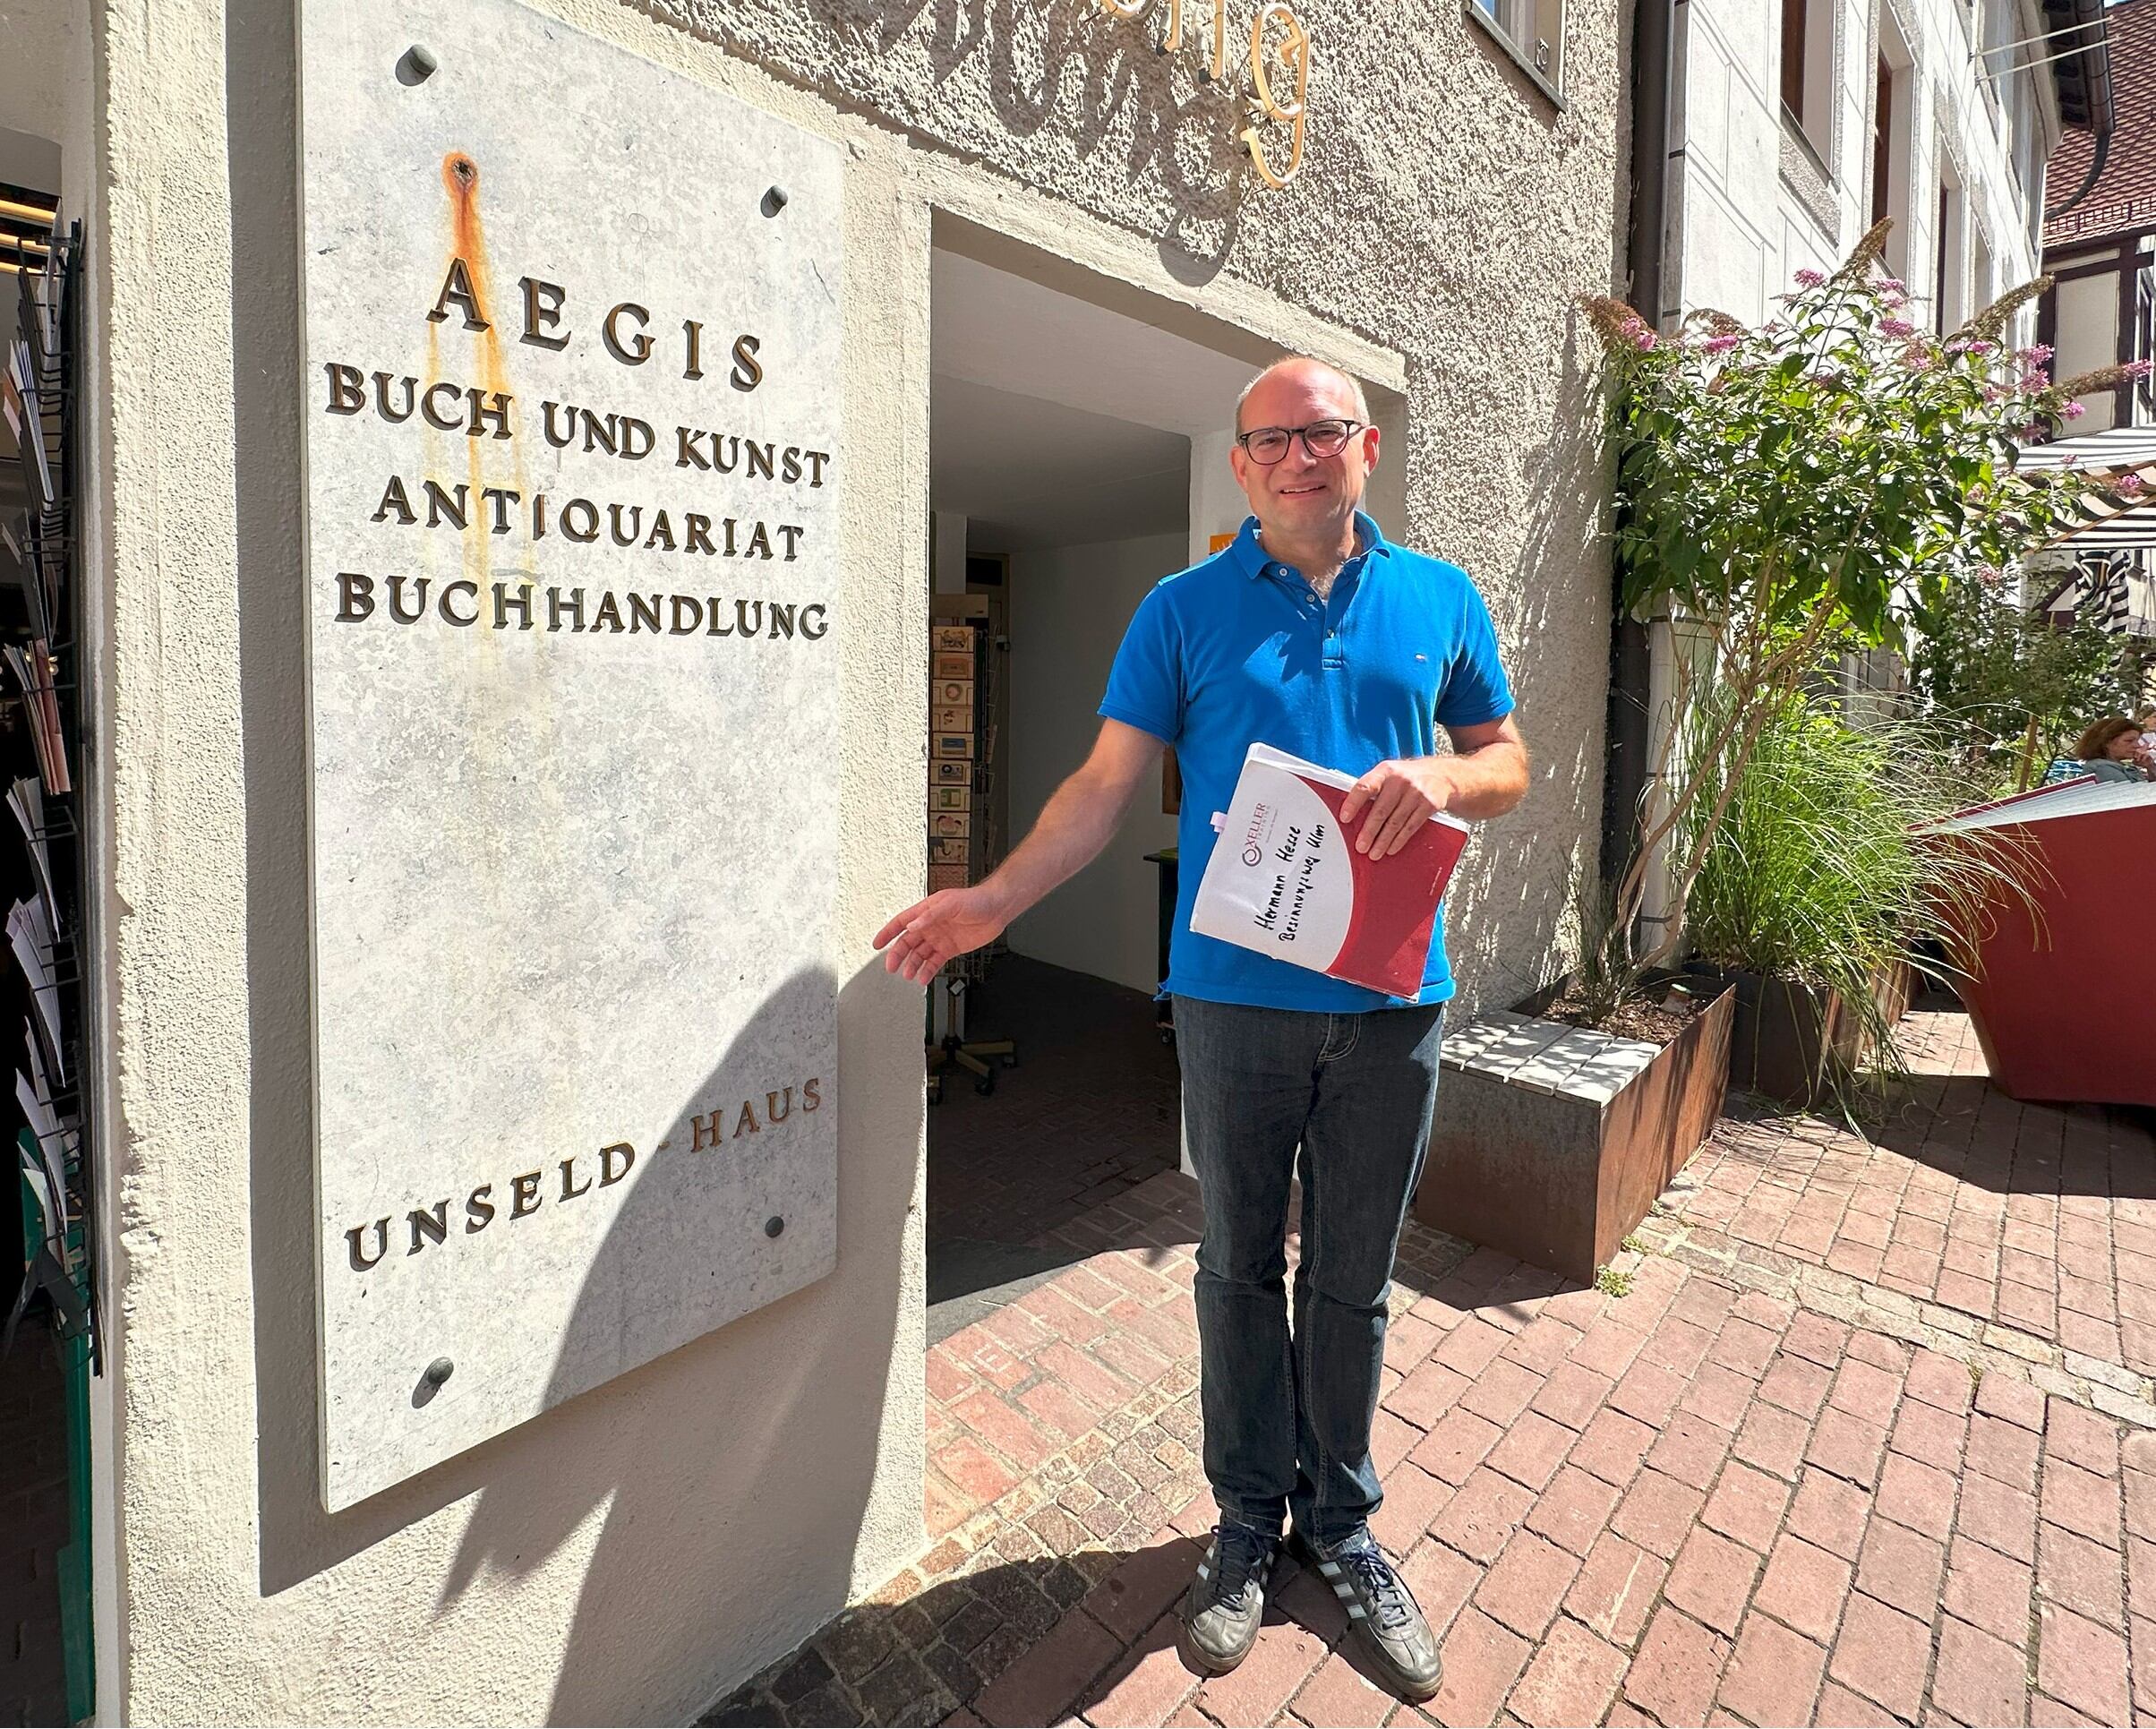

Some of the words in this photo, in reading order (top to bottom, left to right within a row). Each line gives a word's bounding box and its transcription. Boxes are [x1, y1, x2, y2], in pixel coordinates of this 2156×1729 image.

[425, 257, 763, 392] AEGIS
[323, 361, 514, 440] BUCH
[540, 399, 655, 460] UND
[675, 425, 830, 489] KUNST
[369, 475, 803, 562] ANTIQUARIAT
[334, 571, 829, 641] BUCHHANDLUNG
[1253, 874, 1286, 930] Hermann
[1275, 826, 1301, 862] Hesse
[1305, 824, 1325, 848] Ulm
